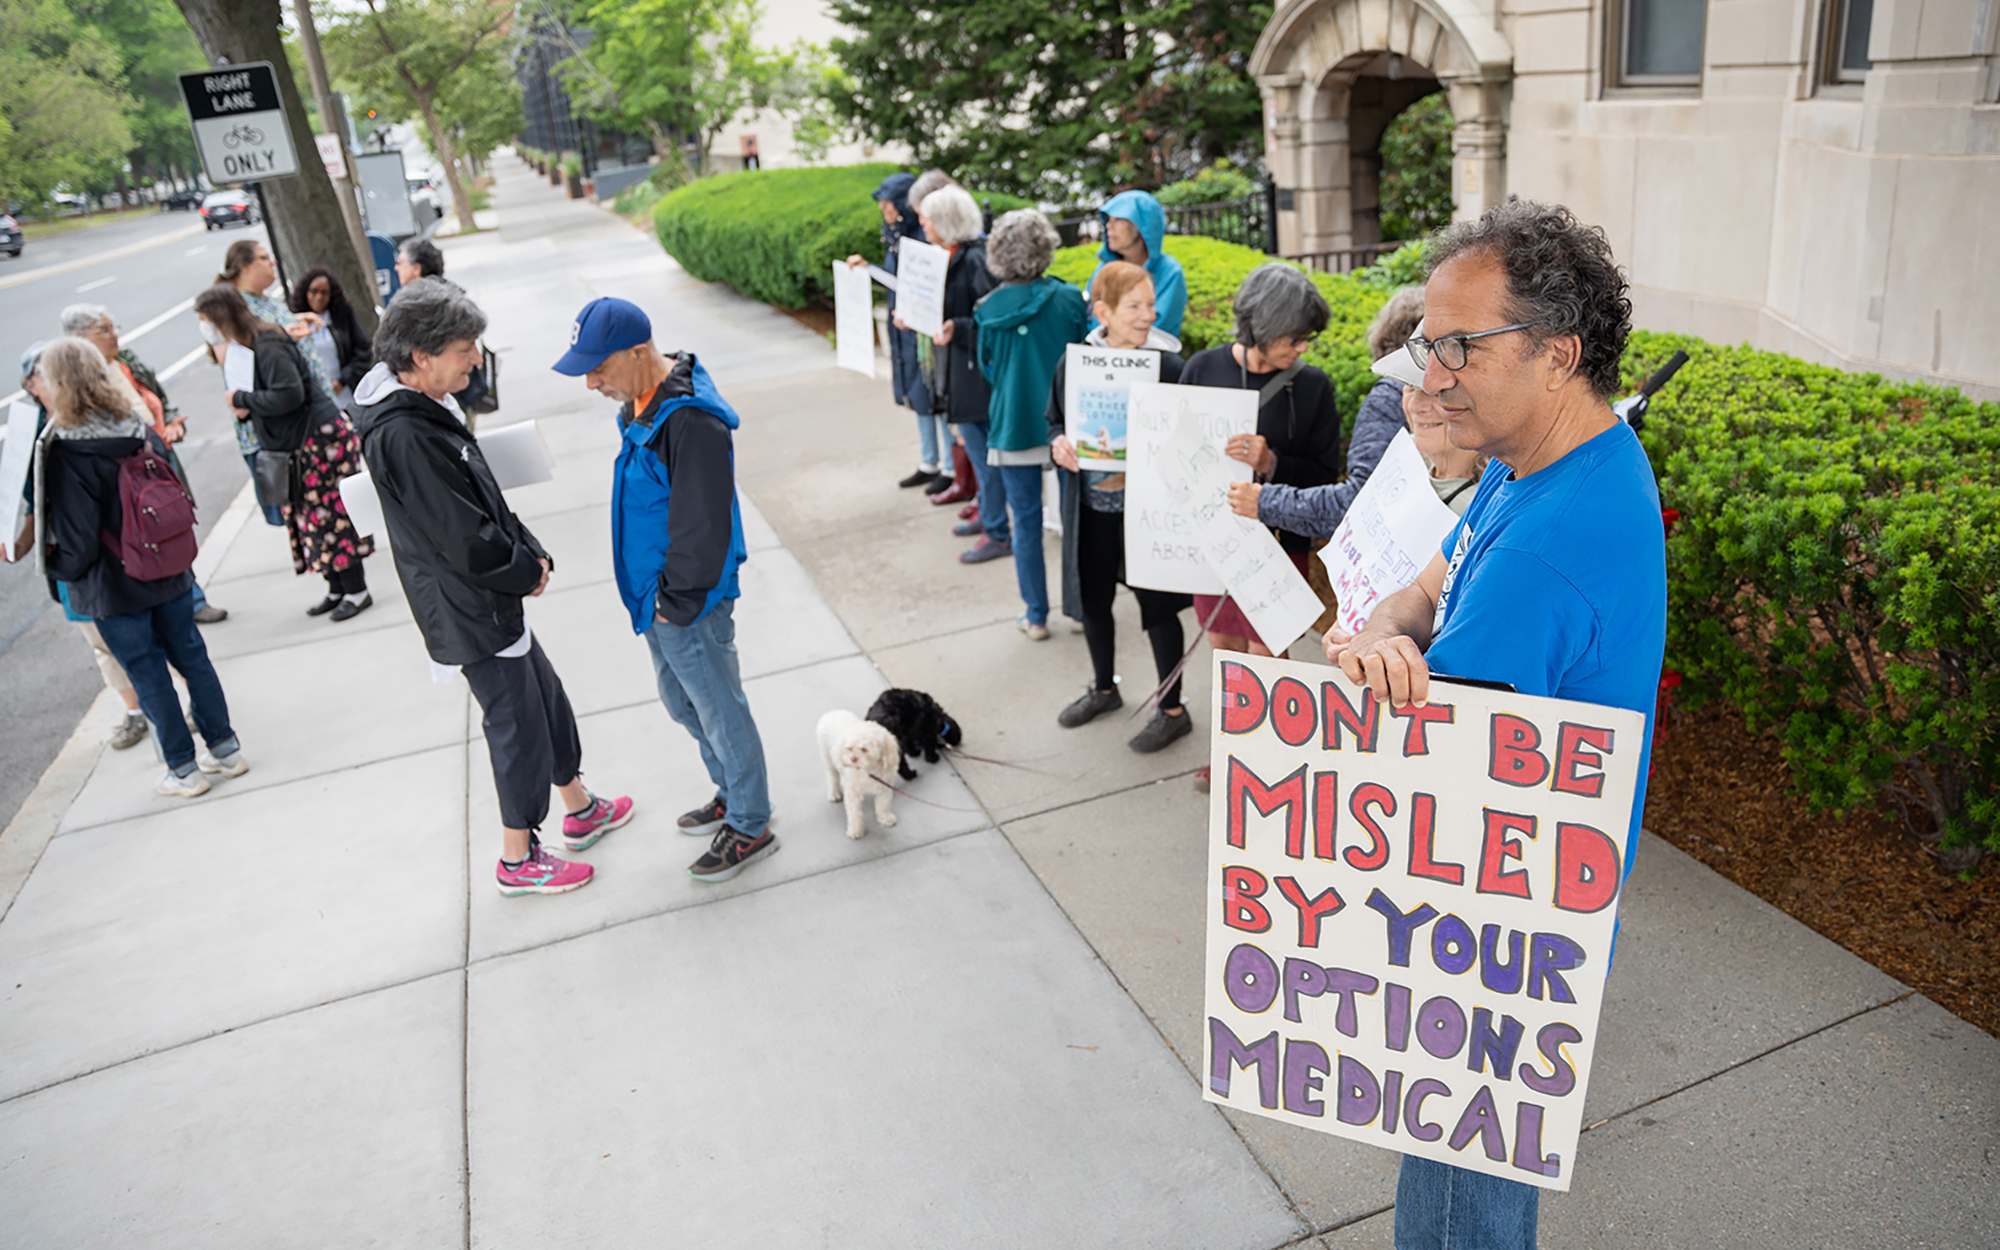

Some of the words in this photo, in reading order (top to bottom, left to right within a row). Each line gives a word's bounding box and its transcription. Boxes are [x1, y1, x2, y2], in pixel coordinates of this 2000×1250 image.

[203, 72, 251, 93] RIGHT
[211, 92, 256, 112] LANE
[223, 149, 274, 176] ONLY
[1082, 356, 1107, 367] THIS
[1111, 357, 1151, 368] CLINIC
[1373, 458, 1408, 507] NO
[1488, 711, 1615, 798] BE
[1226, 754, 1624, 914] MISLED
[1222, 863, 1347, 948] BY
[1365, 887, 1587, 1004] YOUR
[1223, 942, 1583, 1097] OPTIONS
[1209, 1016, 1561, 1178] MEDICAL
